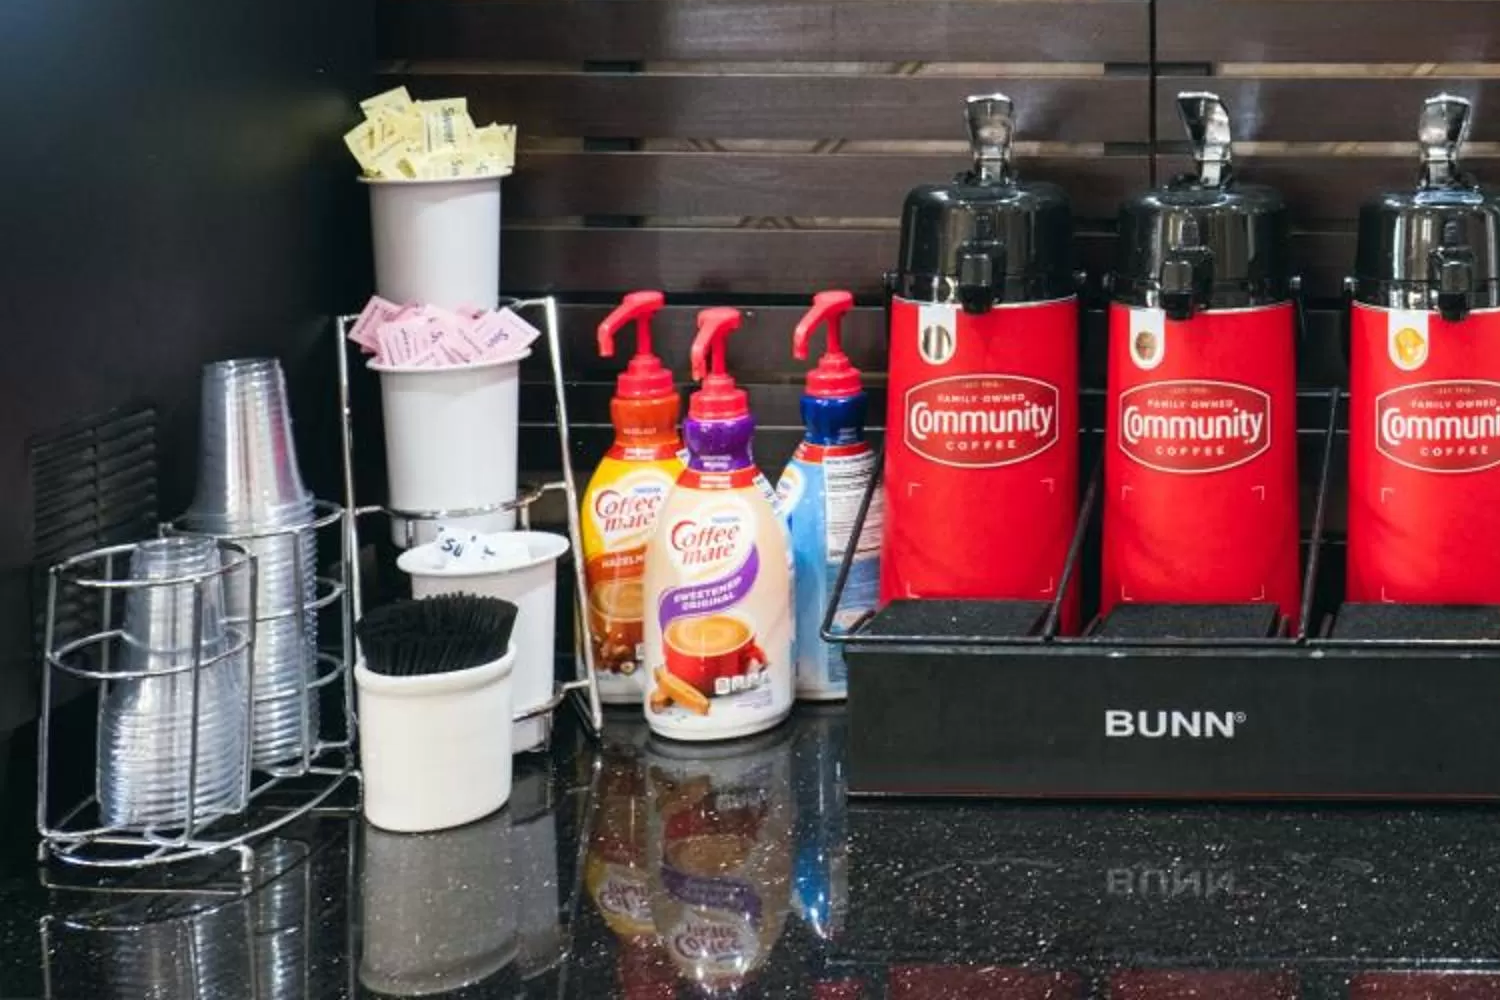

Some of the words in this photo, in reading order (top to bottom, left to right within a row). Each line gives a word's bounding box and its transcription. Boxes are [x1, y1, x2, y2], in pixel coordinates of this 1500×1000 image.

[910, 400, 1053, 441] Community
[1123, 406, 1264, 445] Community
[945, 439, 1017, 451] COFFEE
[1155, 445, 1226, 457] COFFEE
[1419, 445, 1489, 457] COFFEE
[595, 490, 661, 518] Coffee
[605, 511, 655, 532] mate
[671, 519, 741, 551] Coffee
[682, 543, 736, 565] mate
[673, 576, 743, 603] SWEETENED
[681, 592, 736, 611] ORIGINAL
[1105, 709, 1235, 738] BUNN
